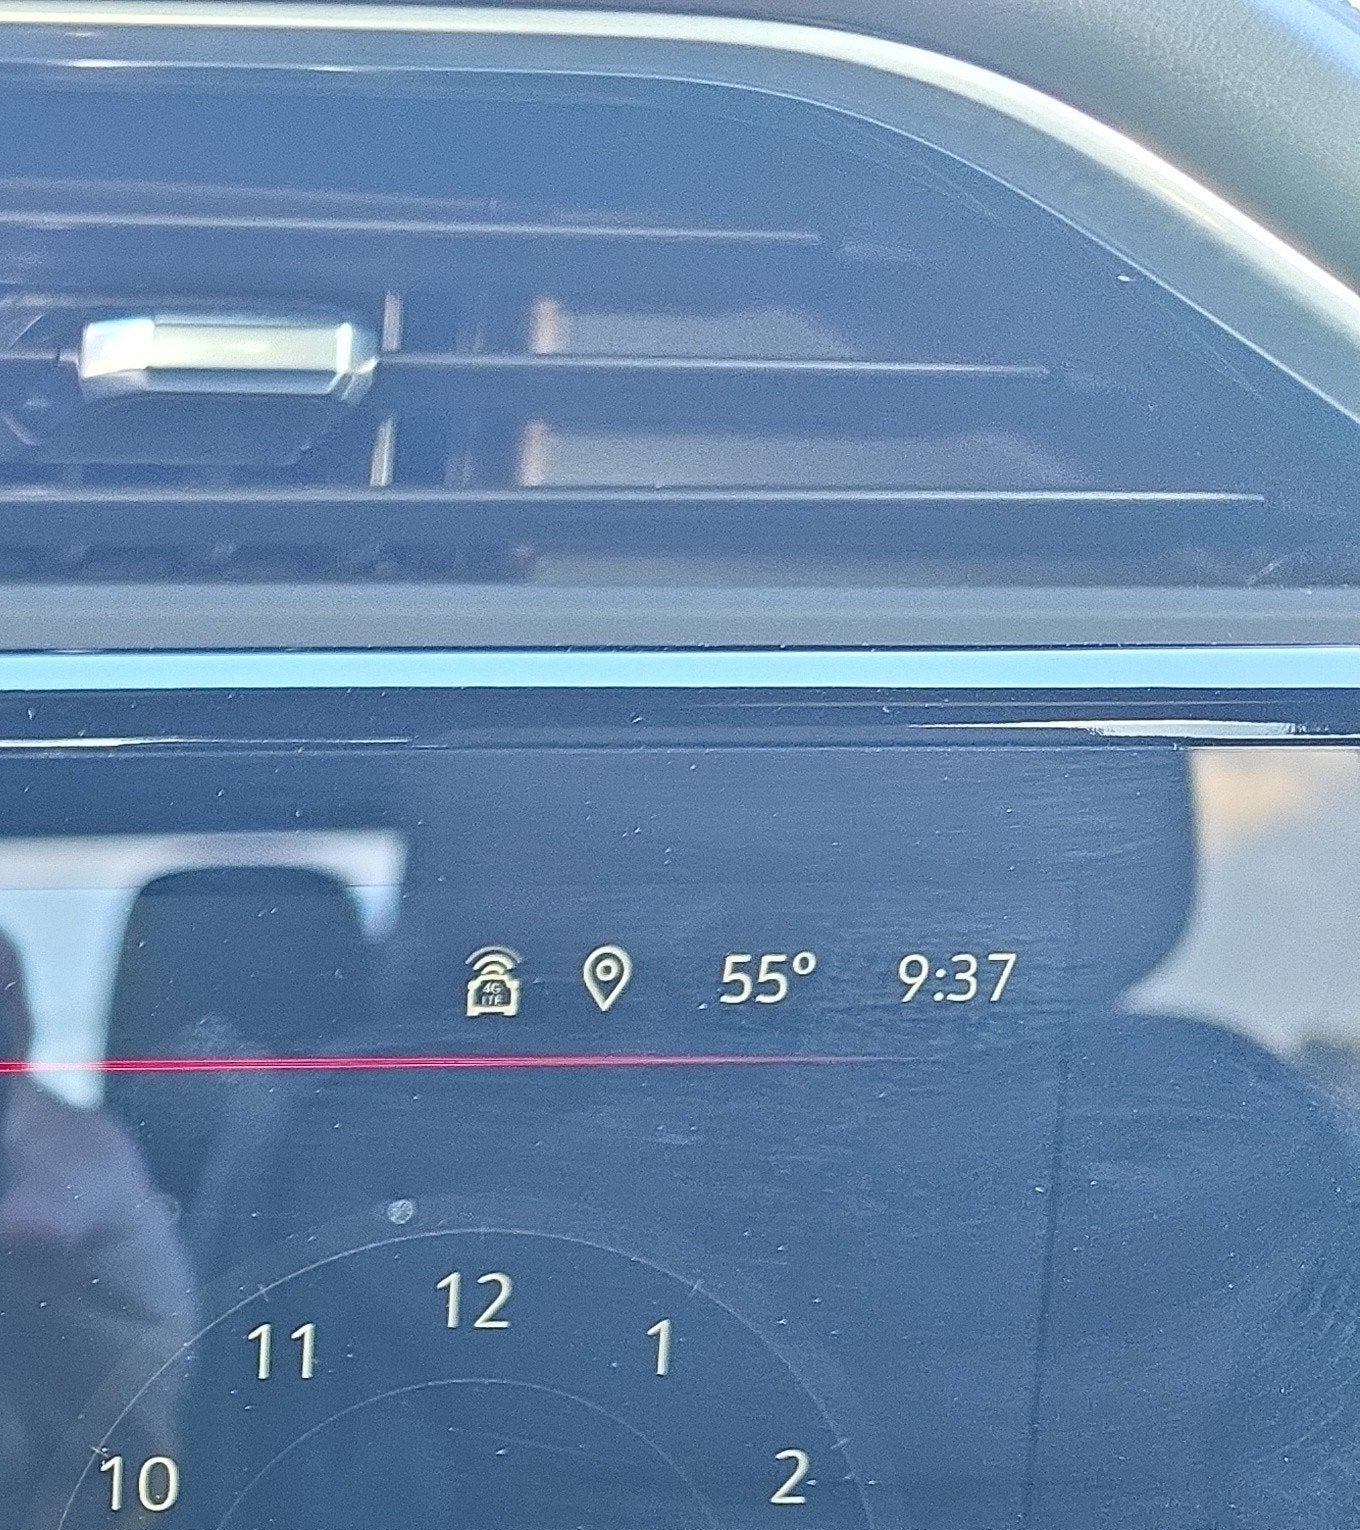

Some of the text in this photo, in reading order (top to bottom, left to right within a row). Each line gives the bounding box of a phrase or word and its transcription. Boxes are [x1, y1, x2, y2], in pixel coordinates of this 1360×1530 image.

[896, 951, 1018, 1003] 9:37
[436, 1271, 515, 1331] 12
[247, 1322, 317, 1381] 11
[646, 1318, 673, 1377] 1
[99, 1454, 181, 1513] 10
[769, 1448, 810, 1506] 2
